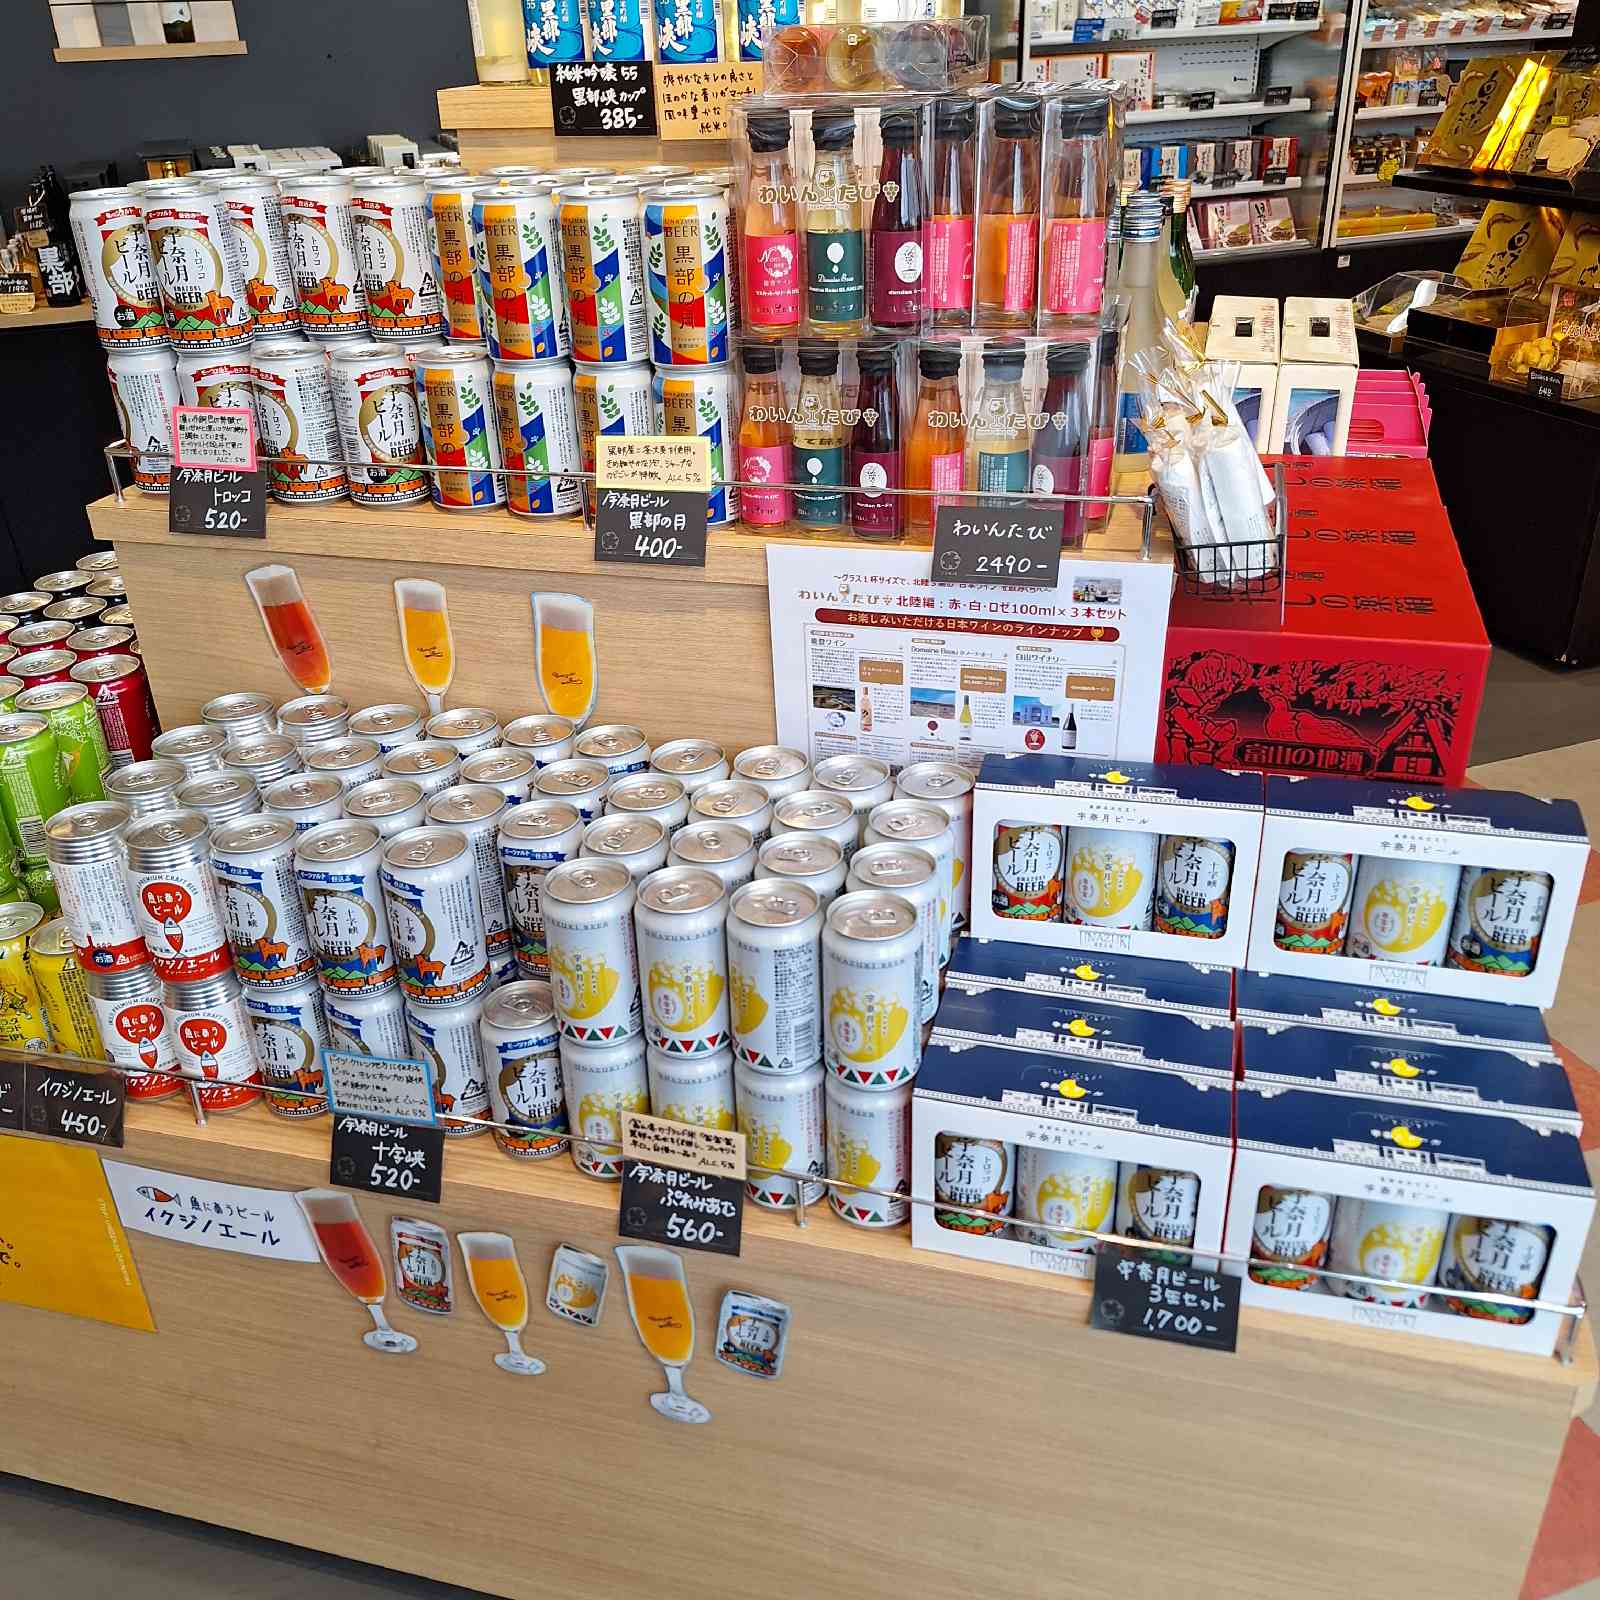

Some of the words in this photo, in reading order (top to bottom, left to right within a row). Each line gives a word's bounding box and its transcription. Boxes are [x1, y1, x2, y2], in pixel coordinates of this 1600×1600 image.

[621, 65, 638, 81] 55
[433, 212, 463, 223] BEER
[485, 224, 517, 236] BEER
[664, 225, 698, 238] BEER
[115, 239, 137, 286] ビール
[239, 237, 249, 268] トロッコ
[311, 236, 321, 266] トロッコ
[376, 238, 387, 269] トロッコ
[38, 246, 75, 296] 黒部
[194, 249, 206, 280] トロッコ
[137, 287, 159, 300] BEE
[494, 244, 518, 325] 黒部の月
[672, 245, 696, 330] 黒部の月
[174, 291, 203, 304] BEER
[426, 385, 455, 397] BEER
[664, 397, 694, 410] BEER
[271, 406, 282, 437] トロッコ
[373, 398, 391, 442] ビール
[749, 405, 862, 426] わいんたび
[927, 410, 1051, 431] わいんたび
[390, 446, 414, 458] BEER
[214, 487, 251, 507] トロッコ
[601, 489, 670, 509] 宇奈月ビール
[204, 508, 248, 530] 520-
[628, 510, 687, 533] 黒部の月
[952, 519, 1053, 540] わいんたび
[634, 533, 683, 560] 400-
[847, 611, 1085, 639] お楽しみいただける日本ワインのラインナップ
[1242, 743, 1363, 772] 富山の地酒
[1077, 811, 1149, 825] 宇奈月ビール
[1005, 836, 1022, 876] ビール
[1168, 843, 1185, 885] ビール
[1016, 881, 1044, 892] BEER
[1286, 863, 1305, 905] ビール
[153, 905, 183, 915] ビール
[1176, 893, 1206, 908] BEER
[1484, 877, 1506, 922] ビール
[1295, 911, 1328, 924] BEER
[1492, 931, 1528, 945] BEER
[323, 945, 353, 956] BEER
[127, 1024, 157, 1039] ビール
[190, 1038, 218, 1049] ビール
[37, 1077, 117, 1105] イクジノエール
[513, 1067, 530, 1104] ビール
[528, 1104, 558, 1119] BEER
[371, 1141, 426, 1169] 十字峡
[370, 1162, 422, 1191] 520-
[628, 1161, 713, 1191] 宇奈月ビール
[660, 1188, 736, 1217] ぷれみあむ
[950, 1191, 982, 1204] BEER
[144, 1206, 281, 1246] イクジノエール
[666, 1212, 724, 1244] 560-
[1154, 1227, 1188, 1240] BEER
[1116, 1258, 1221, 1292] 宇奈月ビール
[1149, 1283, 1225, 1312] 3缶セット
